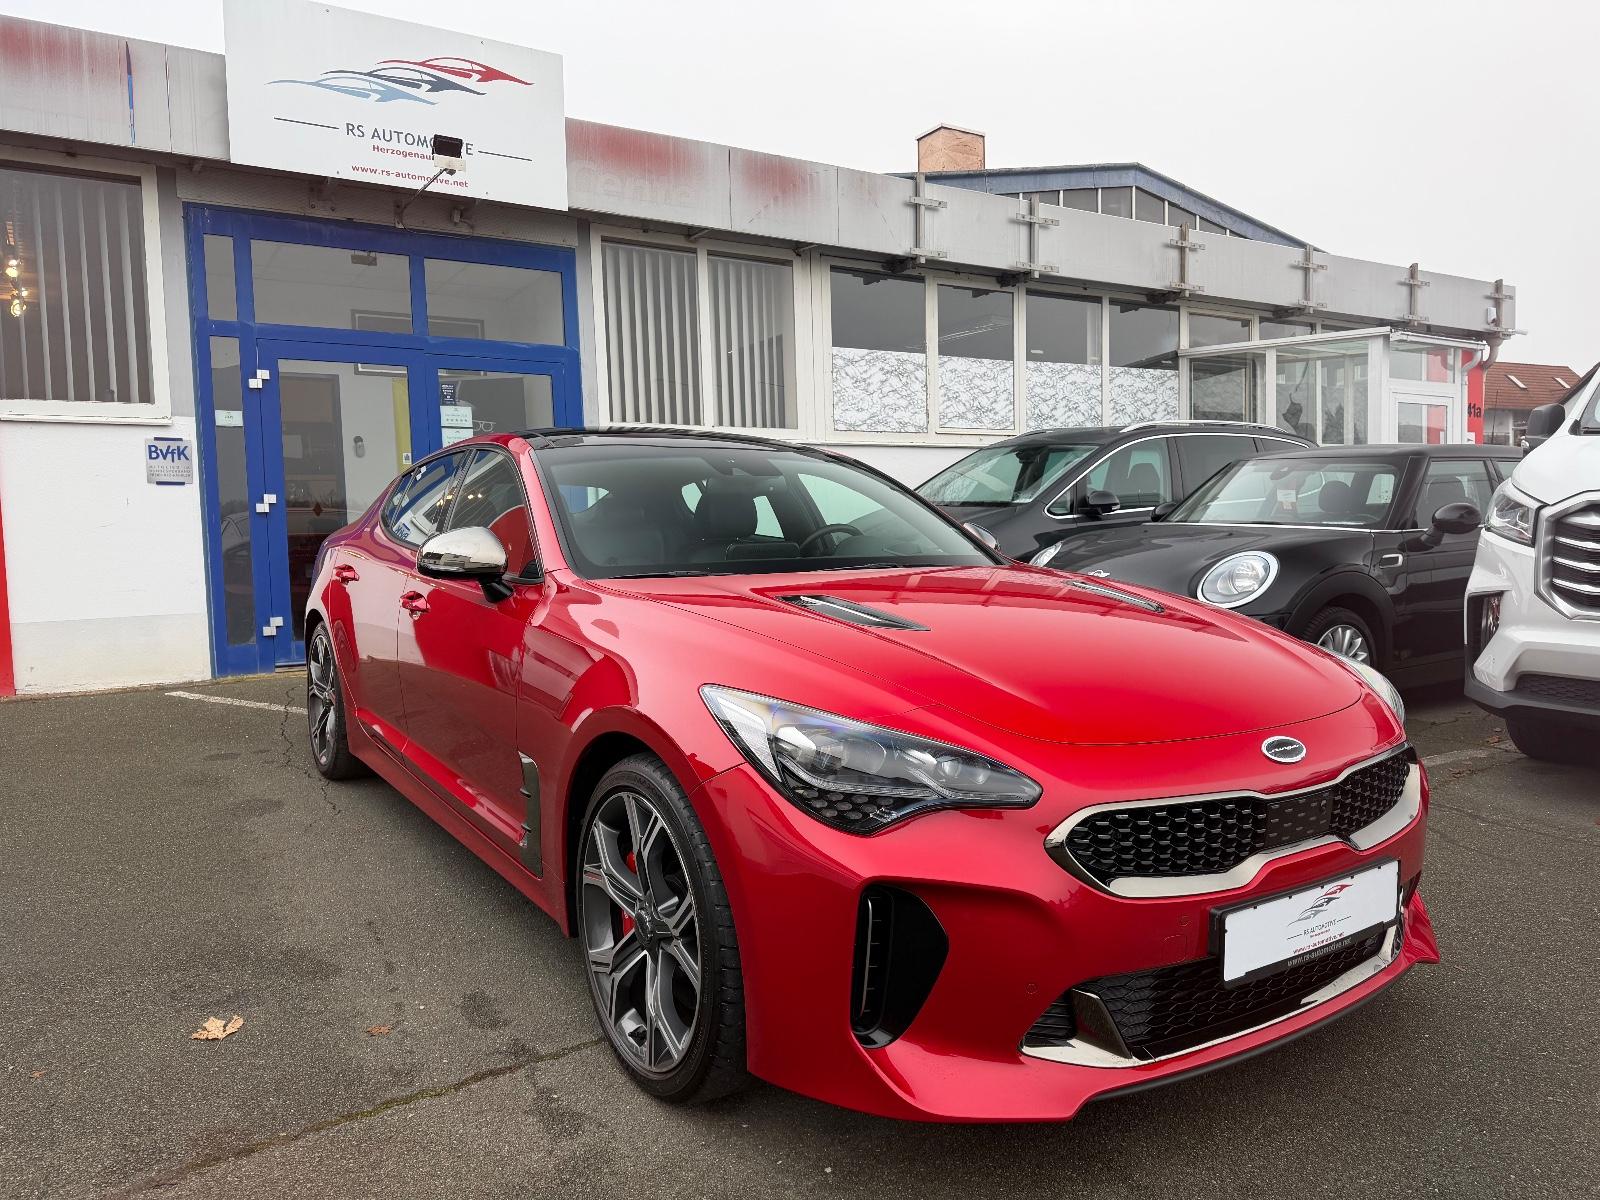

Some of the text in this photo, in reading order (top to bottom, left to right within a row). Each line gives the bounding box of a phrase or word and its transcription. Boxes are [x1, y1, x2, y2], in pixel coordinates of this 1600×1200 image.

[346, 122, 474, 156] RS AUTOME
[372, 144, 432, 161] Herzogenau
[351, 165, 469, 188] www.rs-automoive.net
